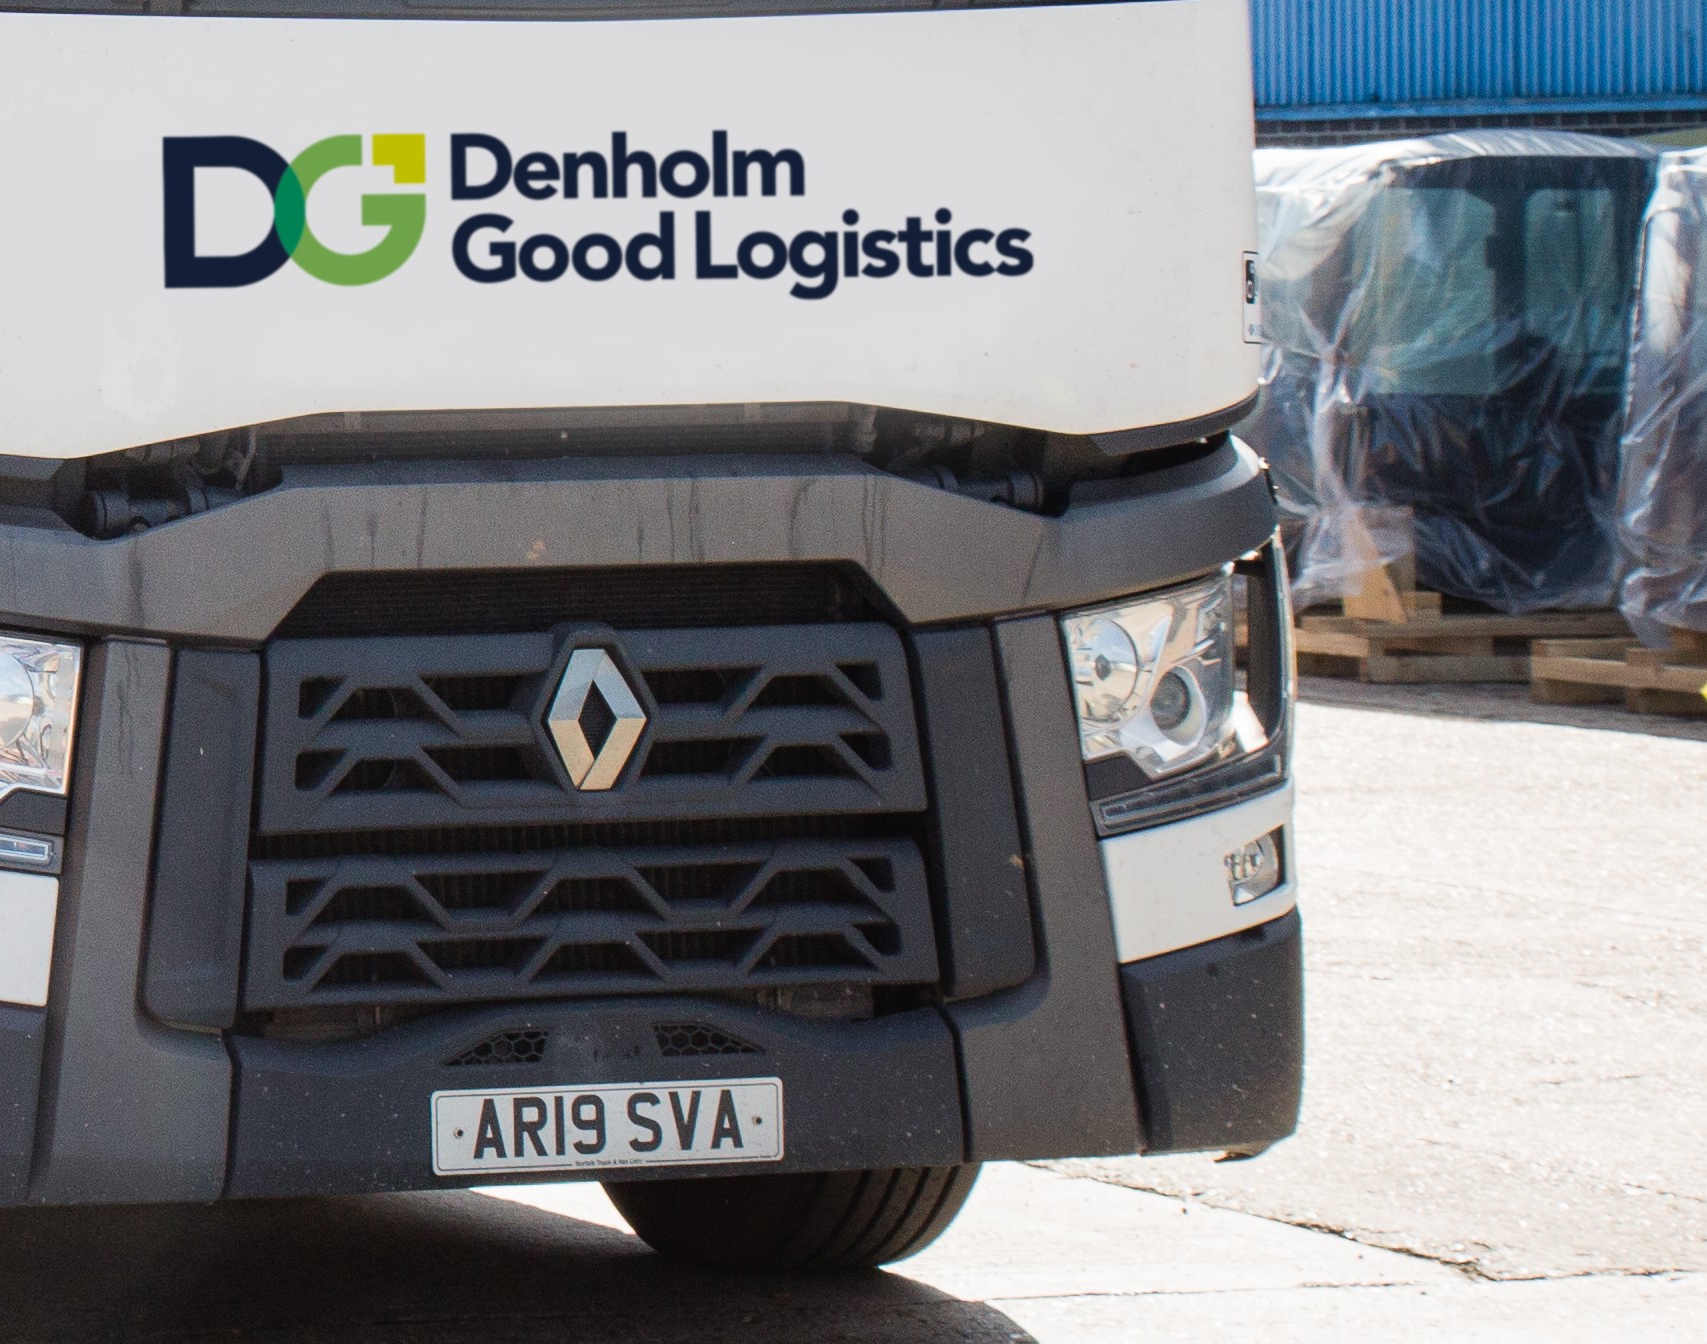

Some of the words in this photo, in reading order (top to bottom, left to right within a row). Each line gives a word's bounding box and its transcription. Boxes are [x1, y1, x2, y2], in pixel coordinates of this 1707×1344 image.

[450, 130, 805, 200] Denholm
[163, 133, 427, 289] DG
[451, 211, 676, 284] Good
[694, 207, 1035, 300] Logistics
[473, 1094, 607, 1160] AR19
[626, 1089, 744, 1153] SVA
